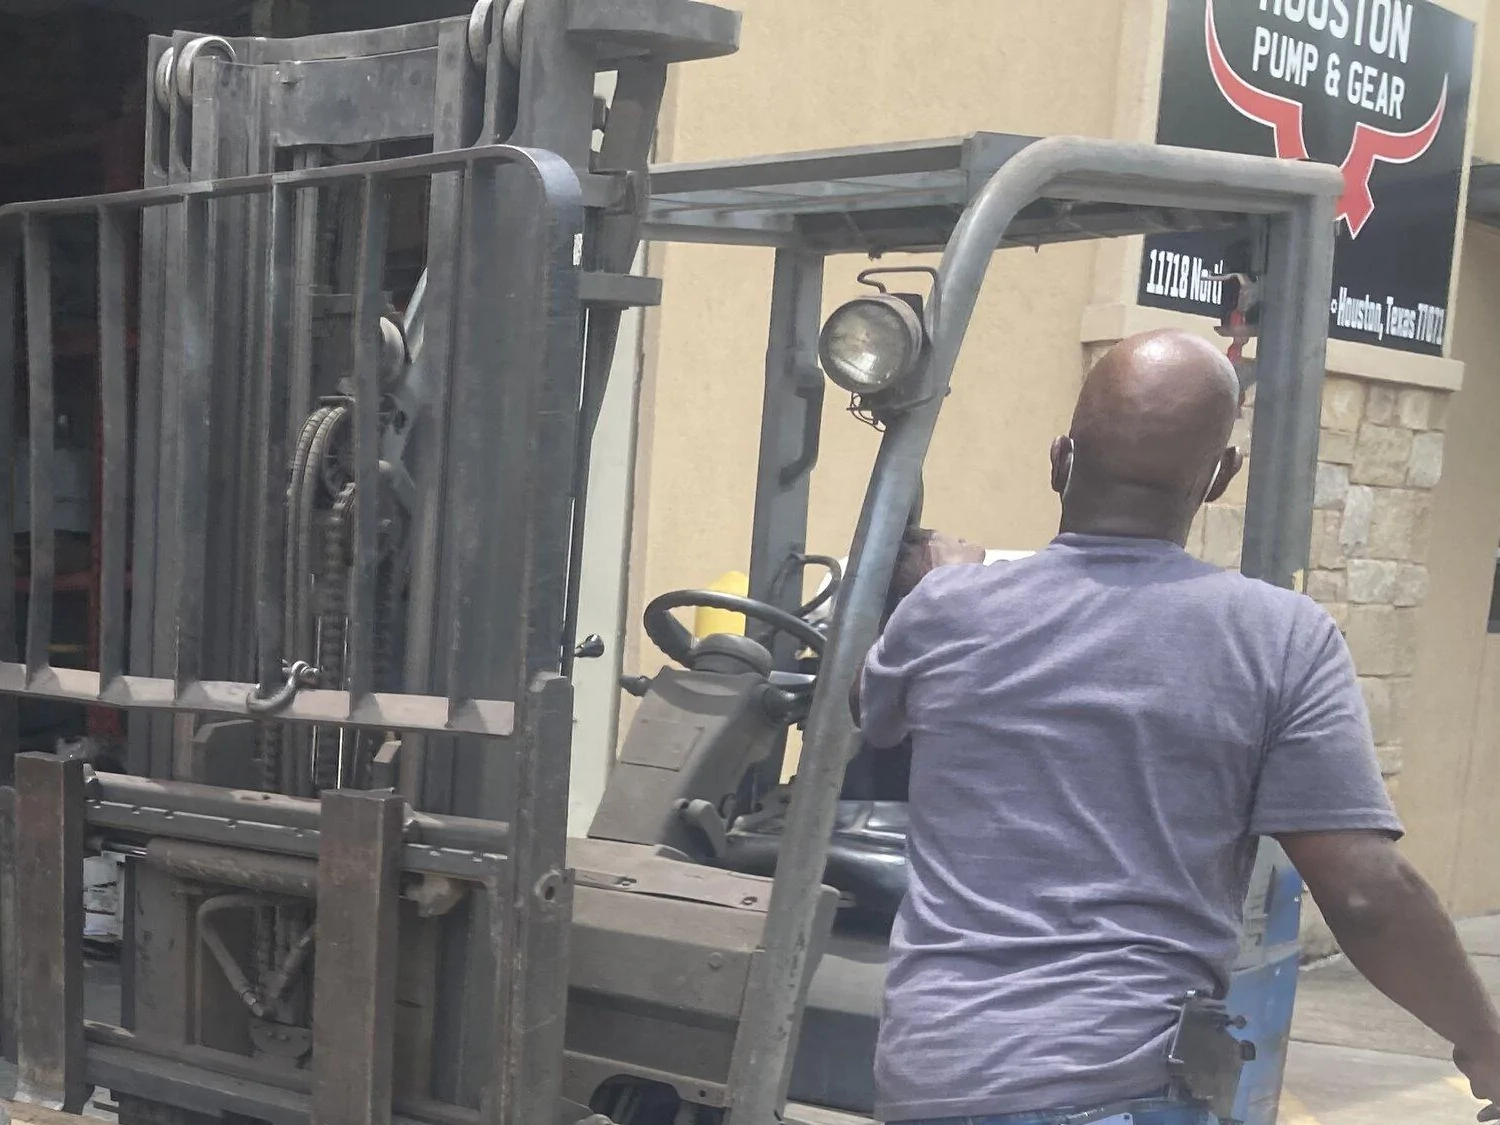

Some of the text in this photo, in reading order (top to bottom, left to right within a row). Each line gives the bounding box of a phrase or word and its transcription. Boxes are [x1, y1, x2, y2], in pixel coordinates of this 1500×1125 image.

[1252, 26, 1406, 120] PUMP & GEAR
[1259, 0, 1414, 64] USTON
[1146, 248, 1190, 299] 11718
[1337, 286, 1384, 341] Houston,
[1386, 296, 1416, 339] Texas
